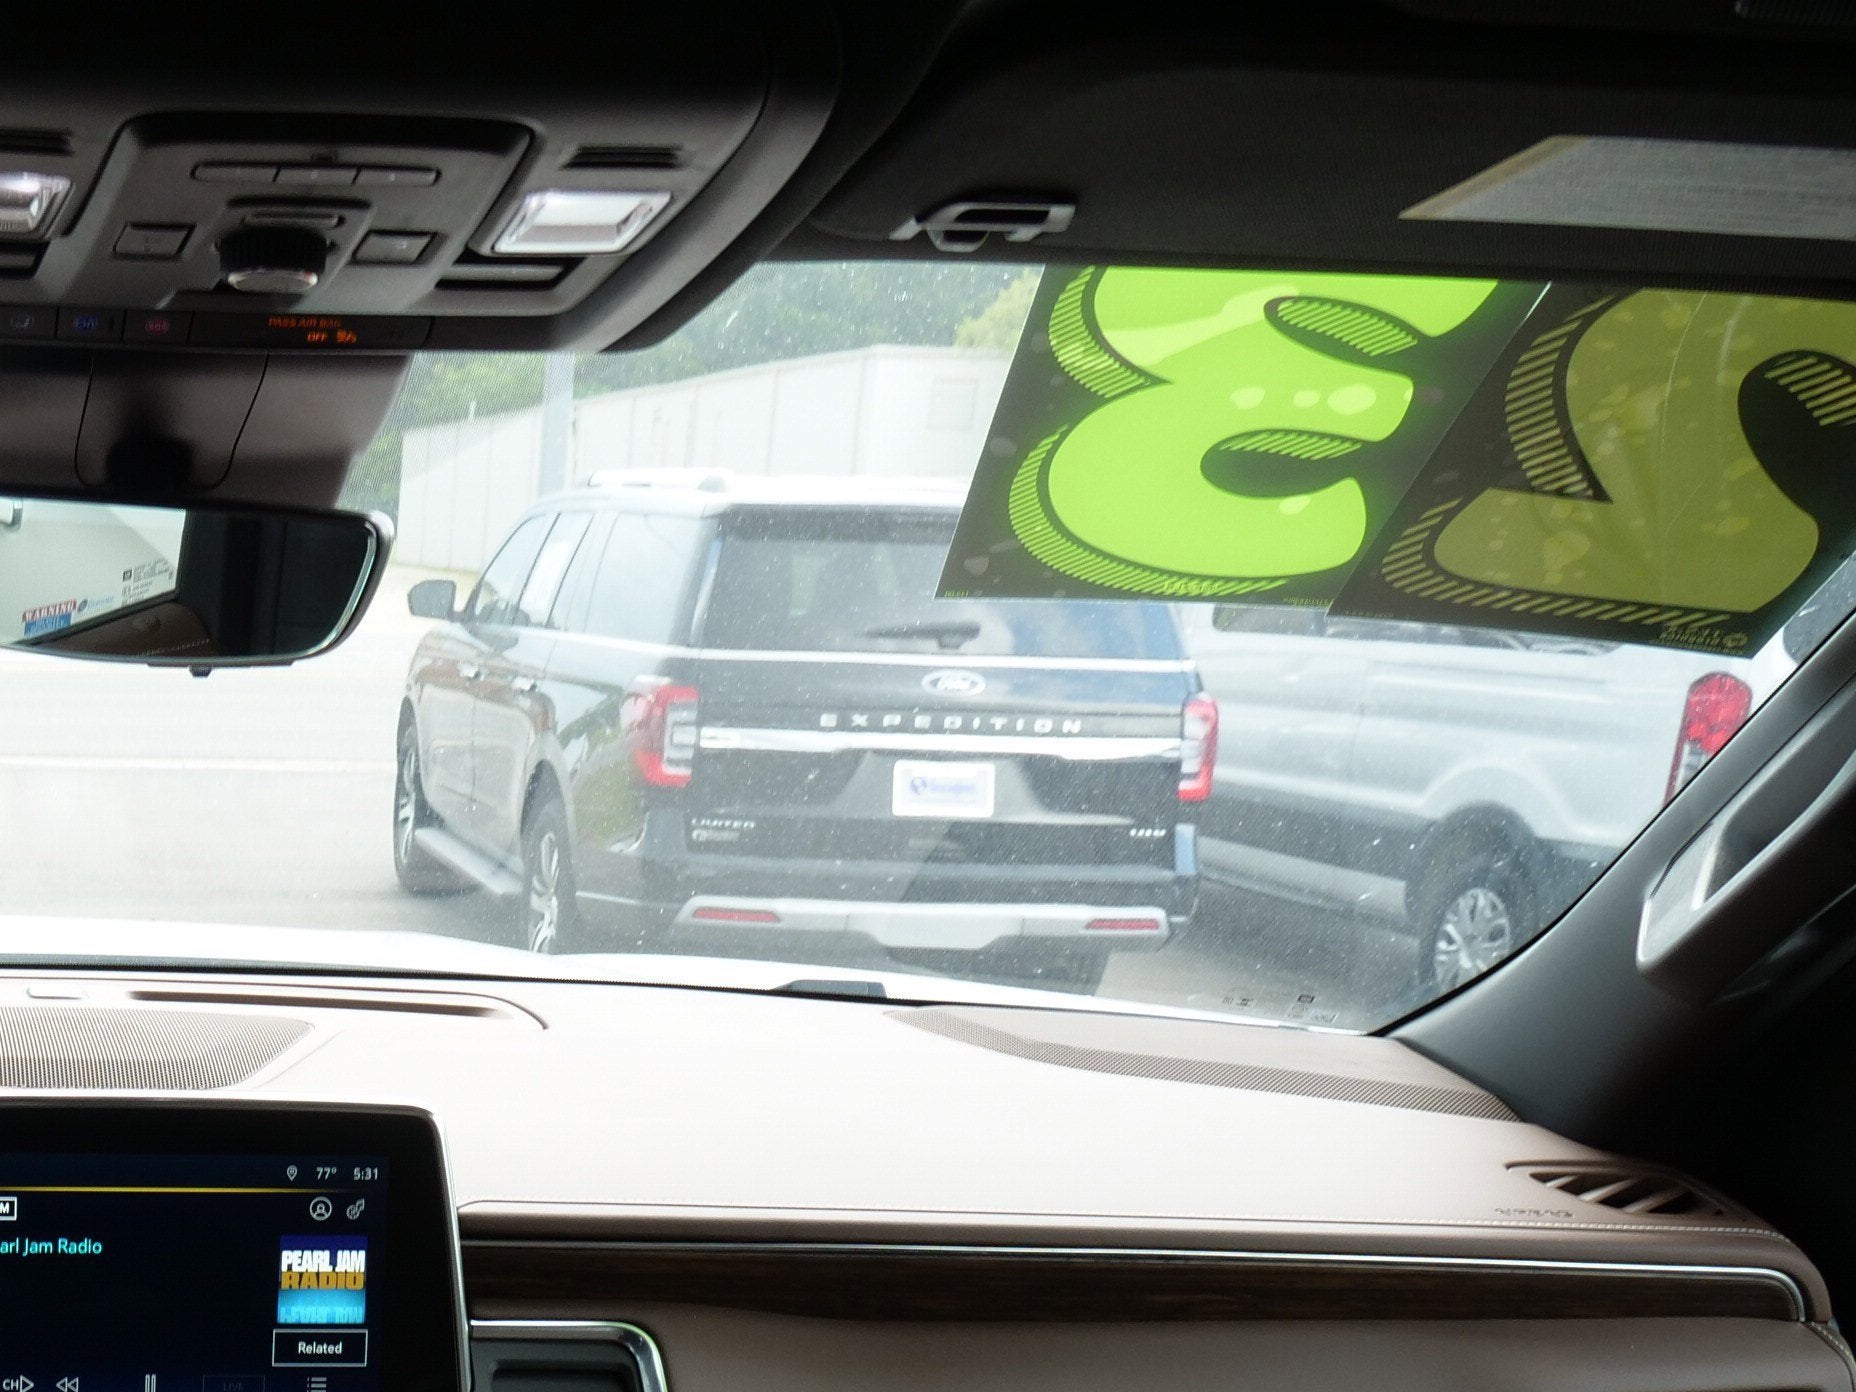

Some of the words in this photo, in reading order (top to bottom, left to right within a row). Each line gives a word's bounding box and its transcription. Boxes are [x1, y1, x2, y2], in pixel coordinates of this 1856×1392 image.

[819, 713, 1082, 735] EXPEDITION
[353, 1167, 378, 1181] 5:31
[23, 1238, 53, 1257] Jam
[58, 1237, 102, 1254] Radio
[281, 1250, 332, 1272] PEARL
[335, 1250, 366, 1272] JAM
[280, 1272, 365, 1290] RADIO
[298, 1341, 342, 1354] Related
[2, 1378, 19, 1391] CH
